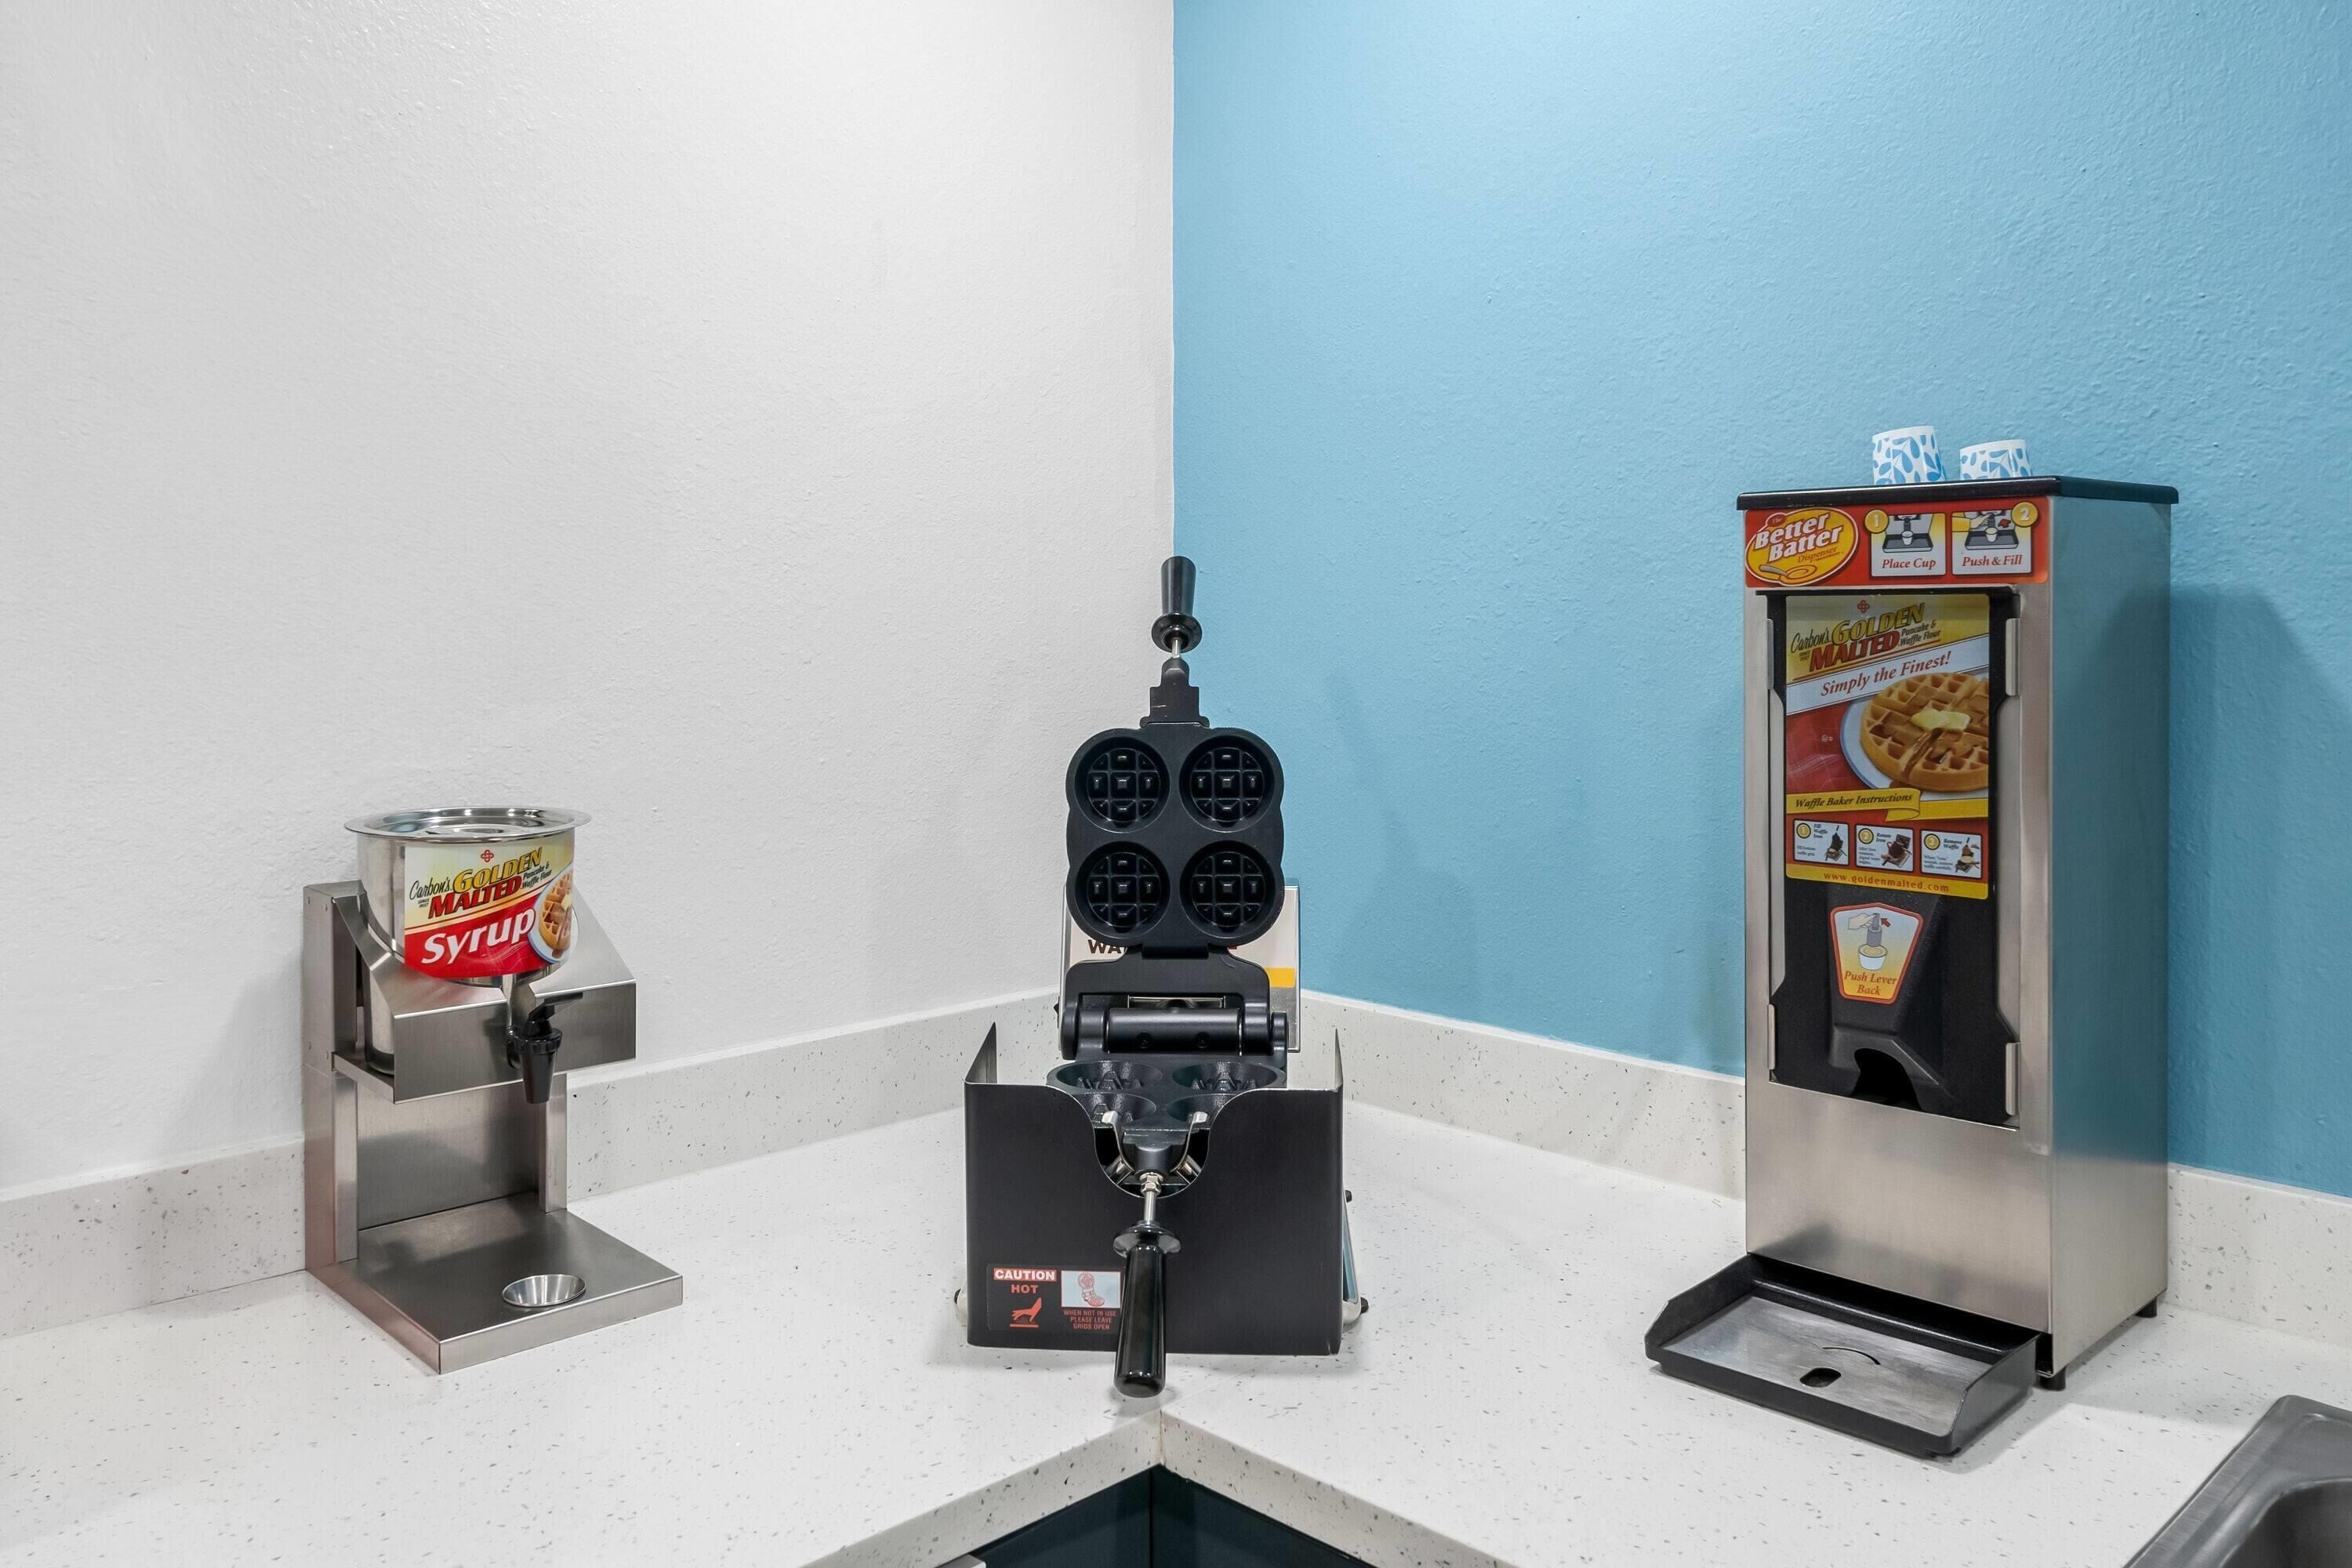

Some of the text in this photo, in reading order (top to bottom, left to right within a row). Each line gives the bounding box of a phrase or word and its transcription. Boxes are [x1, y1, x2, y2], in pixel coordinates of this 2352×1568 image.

[1873, 515, 1880, 528] 1
[2020, 508, 2030, 521] 2
[1755, 513, 1830, 550] Better
[1768, 525, 1843, 563] Batter
[1798, 547, 1838, 563] Dispenser
[1962, 554, 2022, 567] Push & Fill
[1882, 558, 1936, 570] Place Cup
[1791, 602, 1925, 653] Carbon's GOLDEN
[1901, 620, 1936, 637] Pancake &
[1900, 630, 1941, 646] Waffle Flour
[1809, 630, 1901, 672] MALTED
[1821, 651, 1952, 696] Simply the Finest!
[1795, 793, 1913, 809] Waffle Baker Instructions
[409, 847, 543, 900] Carbon's GOLDEN
[1823, 872, 1950, 892] www.goldenmalted.com
[428, 875, 522, 919] MALTED
[421, 908, 536, 965] Syrup
[1844, 971, 1897, 985] Push Lever
[1857, 984, 1882, 996] Back
[995, 1269, 1055, 1281] CAUTION
[1011, 1285, 1038, 1293] HOT
